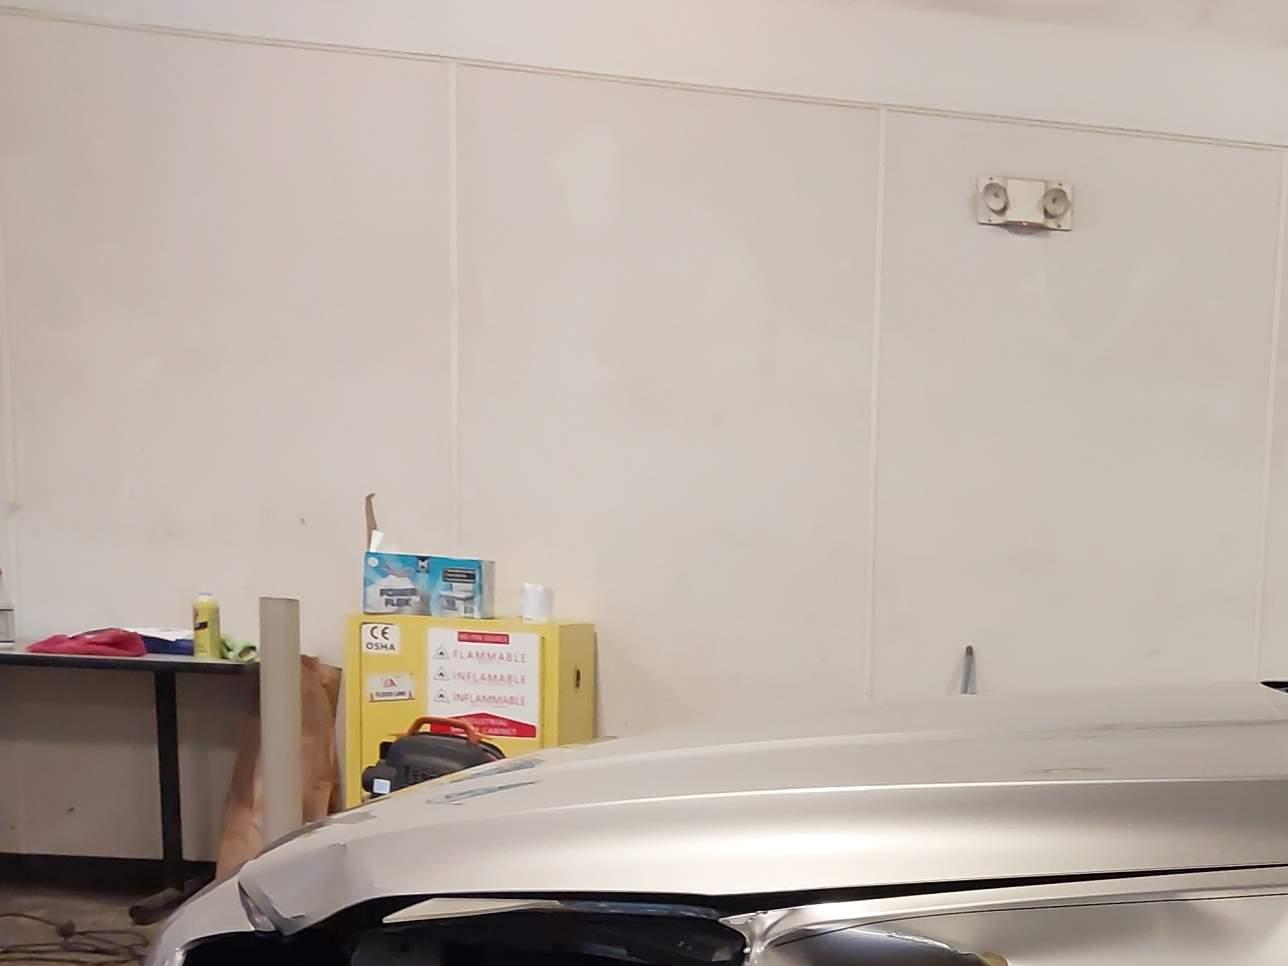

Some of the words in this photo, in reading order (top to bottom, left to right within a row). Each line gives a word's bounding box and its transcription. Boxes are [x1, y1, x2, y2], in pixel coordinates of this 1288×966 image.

[370, 625, 390, 640] CE
[365, 642, 396, 651] OSHA
[452, 649, 527, 663] FLAMMABLE
